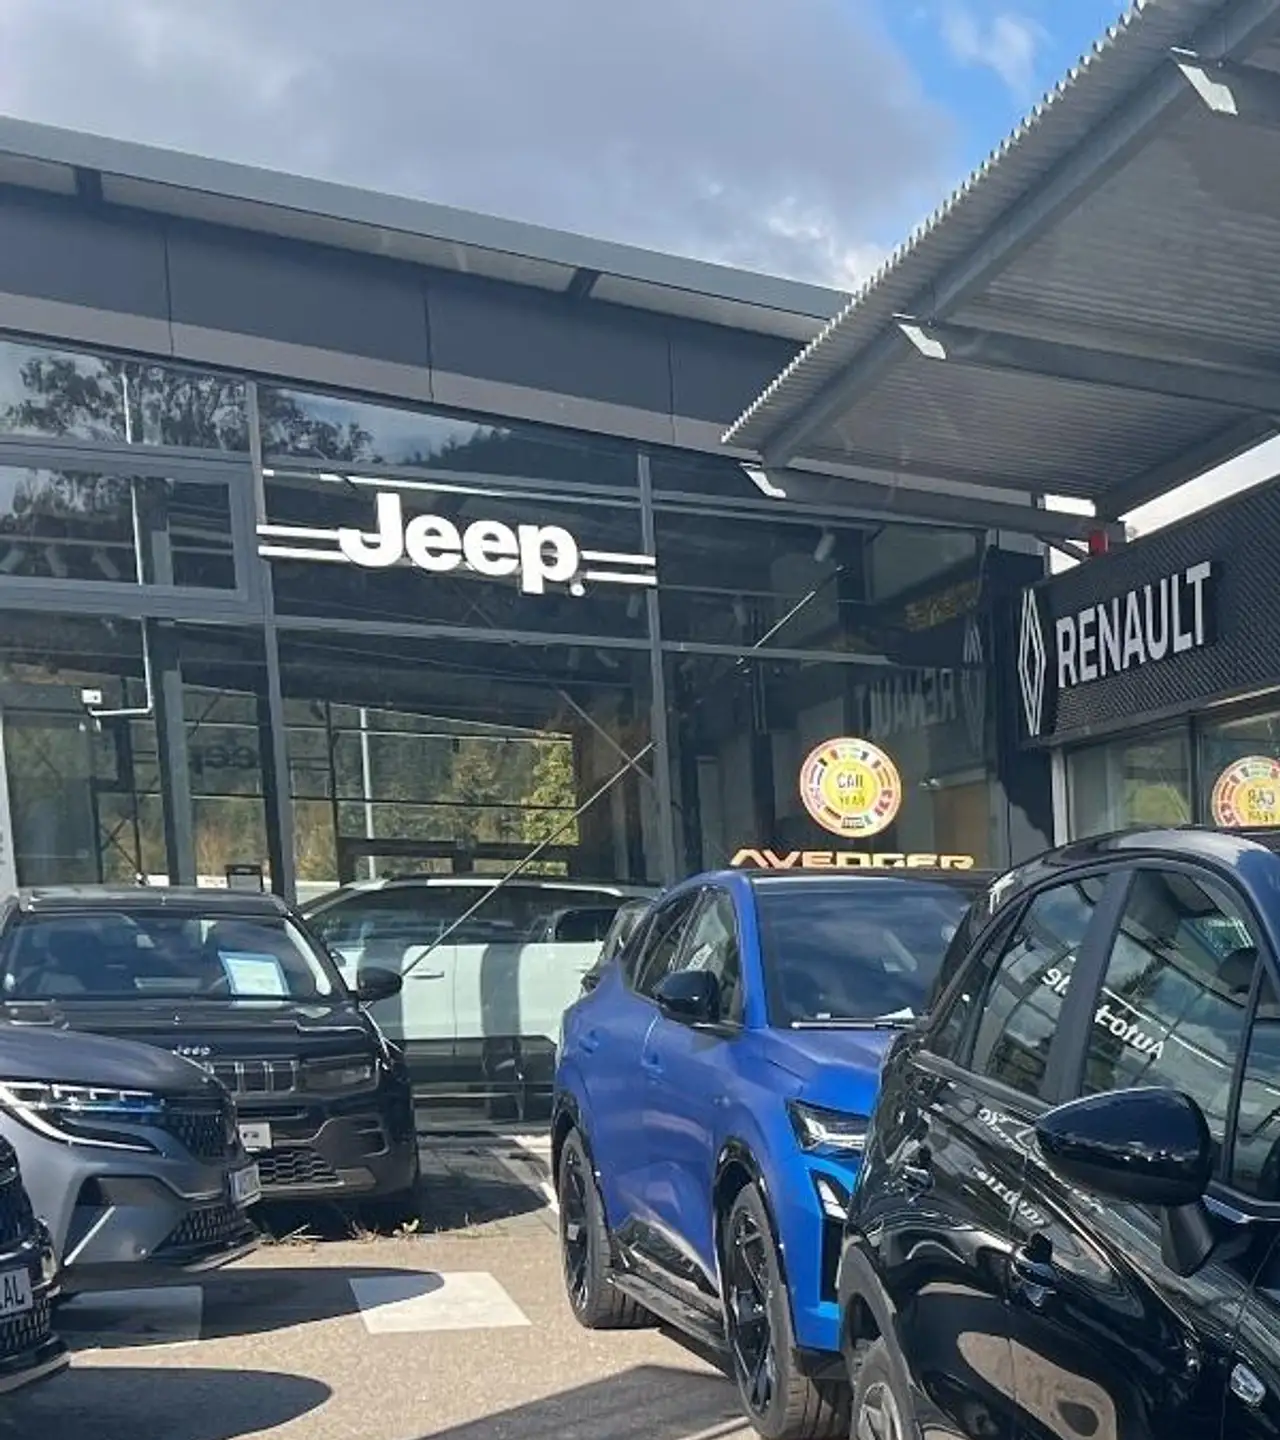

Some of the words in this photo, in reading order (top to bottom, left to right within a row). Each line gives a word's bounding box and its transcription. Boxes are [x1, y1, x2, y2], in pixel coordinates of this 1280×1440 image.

[339, 493, 584, 596] Jeep
[1056, 561, 1211, 688] RENAULT
[731, 849, 974, 869] AVENGER
[0, 1273, 25, 1309] AL
